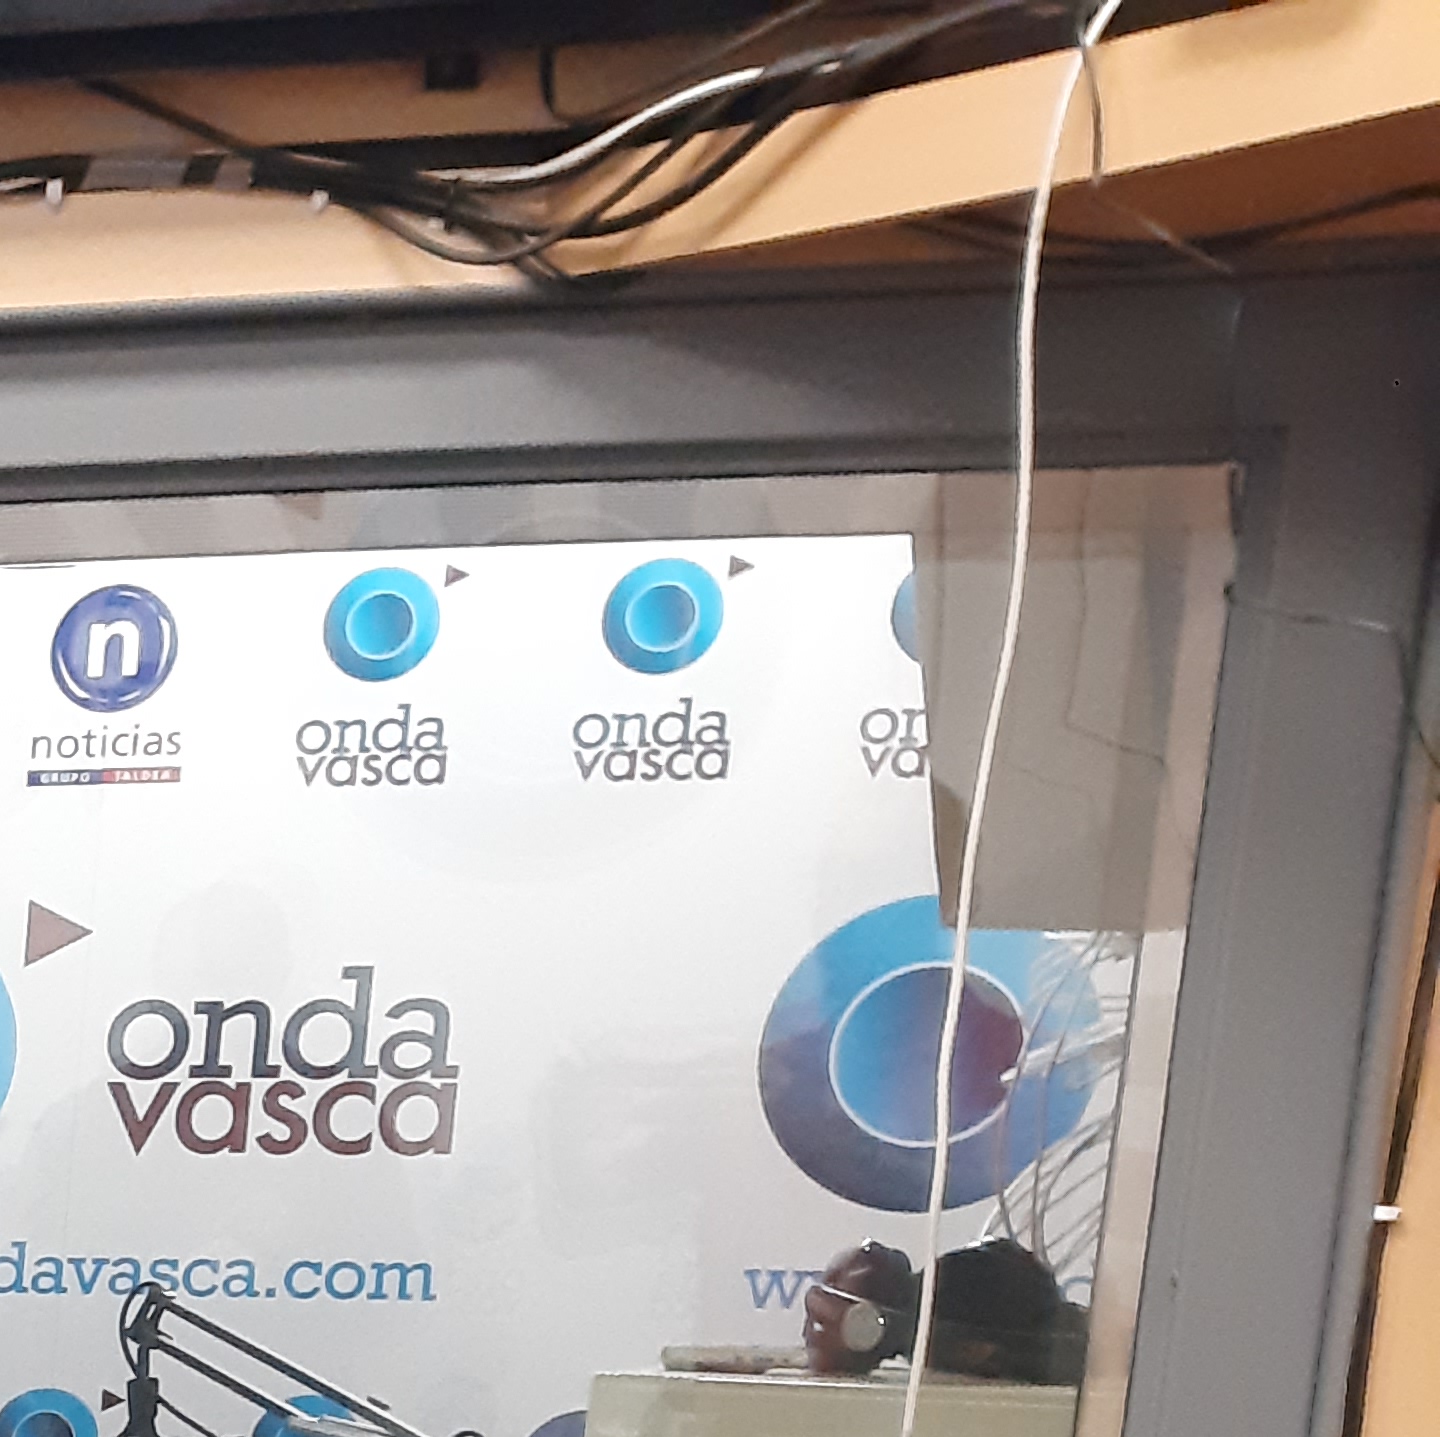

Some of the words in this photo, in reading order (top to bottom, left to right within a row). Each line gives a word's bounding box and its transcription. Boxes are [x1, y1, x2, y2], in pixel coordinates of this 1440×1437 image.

[31, 724, 182, 759] noticias
[296, 704, 449, 757] onda
[573, 697, 732, 750] onda
[296, 753, 448, 787] vasca
[573, 746, 732, 782] vasca
[107, 966, 460, 1079] onda
[107, 1080, 458, 1156] vasca
